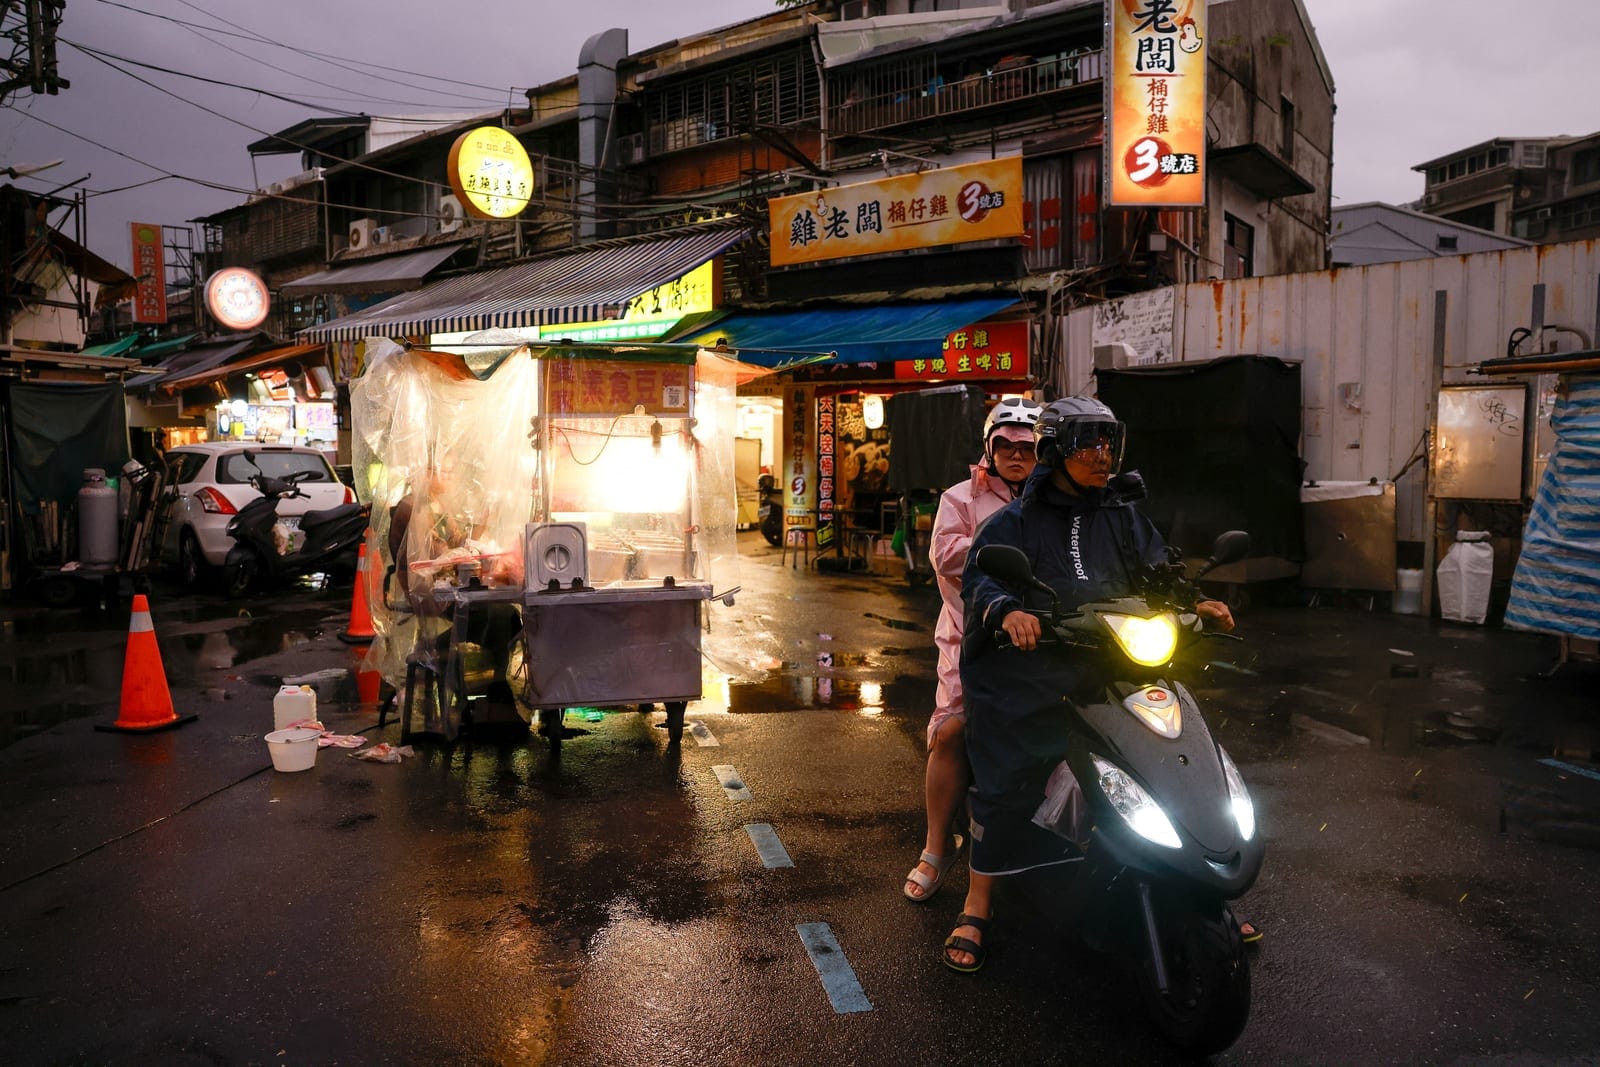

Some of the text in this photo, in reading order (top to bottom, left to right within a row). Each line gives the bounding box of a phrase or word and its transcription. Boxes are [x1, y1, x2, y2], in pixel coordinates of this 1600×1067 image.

[1132, 0, 1178, 72] 老闆
[1146, 78, 1169, 134] 桶仔雞
[789, 199, 883, 247] 雞老闆
[887, 193, 949, 224] 桶仔雞
[957, 352, 1012, 373] 生啤酒
